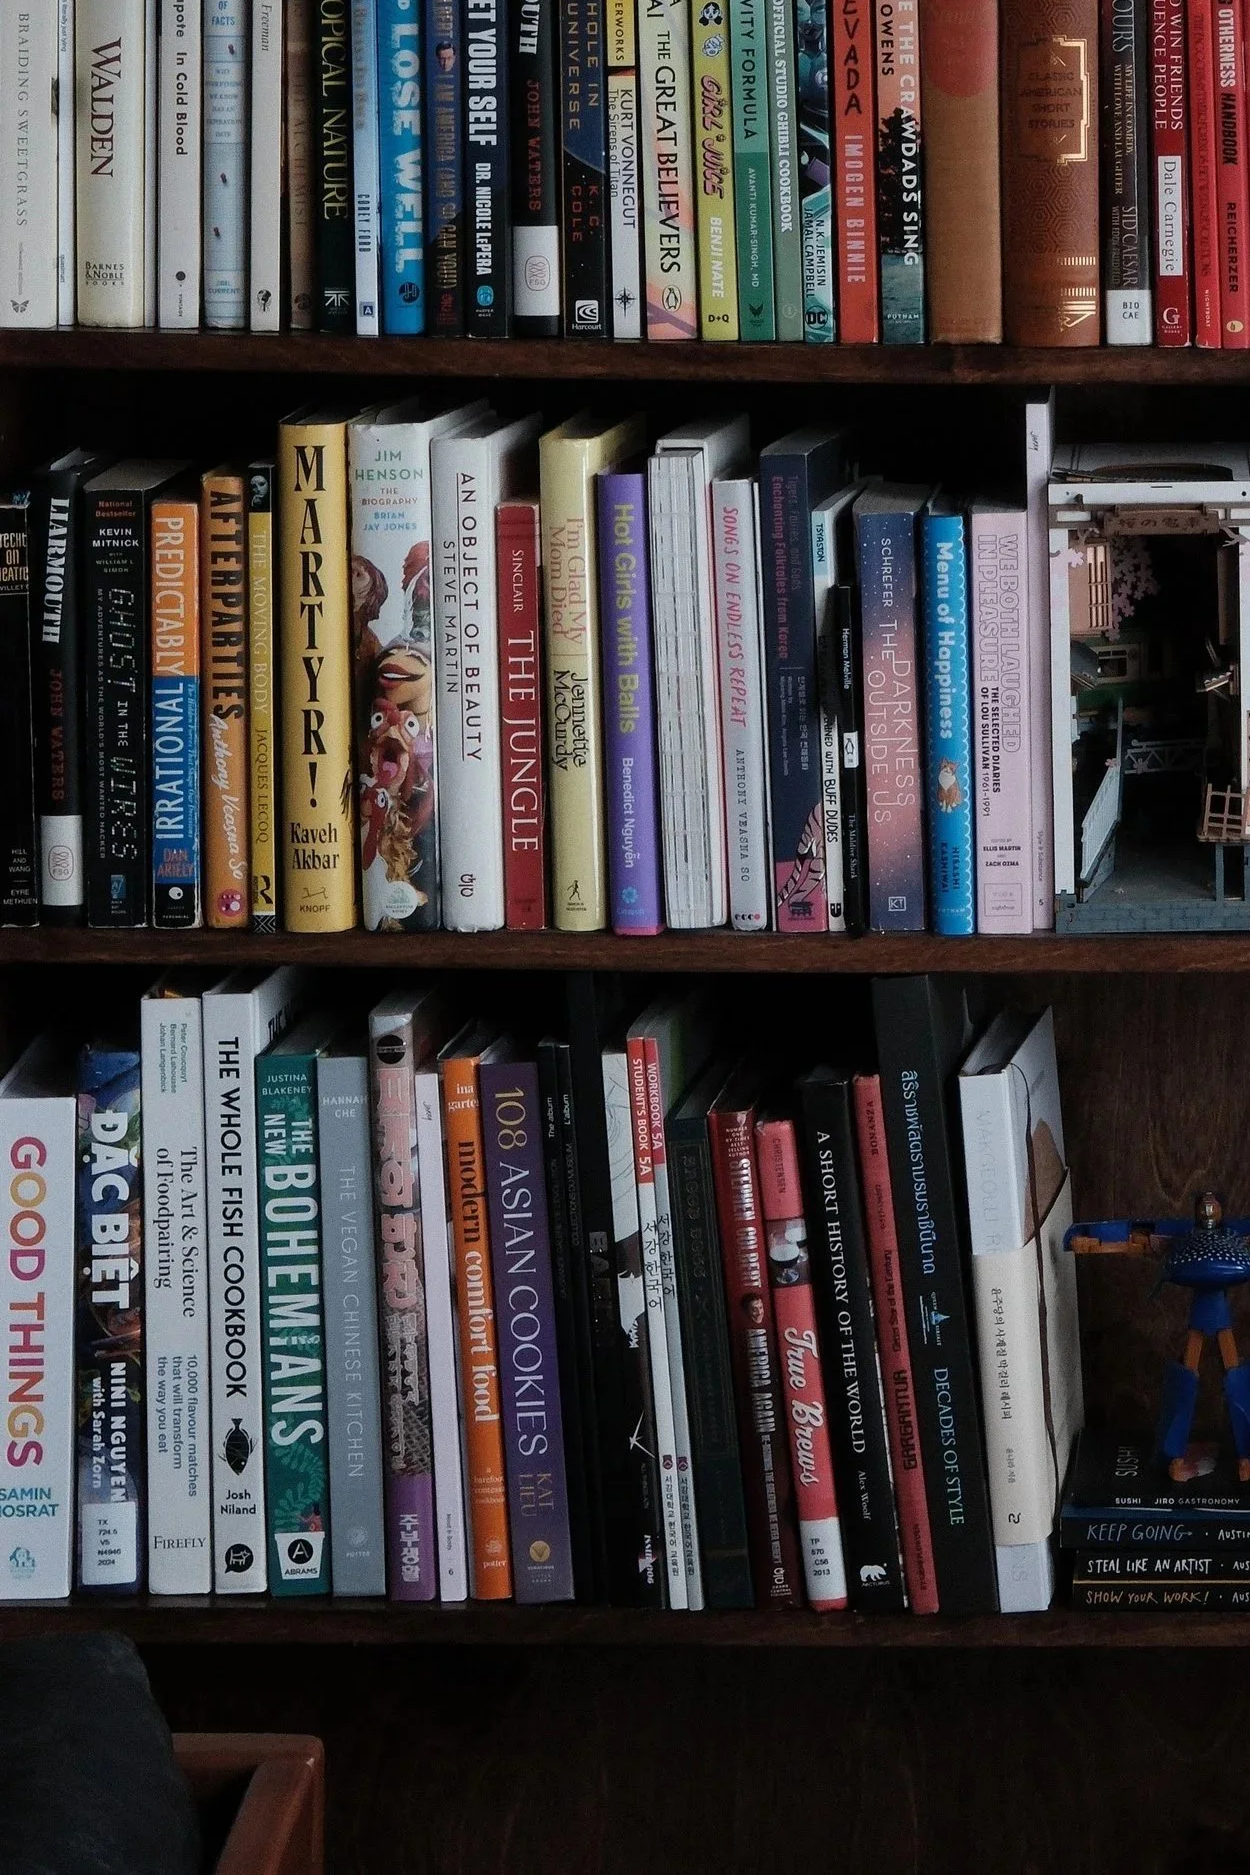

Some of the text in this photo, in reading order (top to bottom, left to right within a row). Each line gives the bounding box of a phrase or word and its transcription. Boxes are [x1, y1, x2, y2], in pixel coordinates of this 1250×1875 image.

[17, 13, 30, 101] BRAIDING
[90, 37, 121, 177] WALDEN
[176, 52, 188, 155] In Cold Blood
[469, 28, 496, 89] YOUR
[17, 110, 29, 226] SWEETGRASS
[323, 109, 348, 220] NATURE
[391, 23, 423, 273] LOSE WELL
[469, 96, 497, 145] SELF
[655, 31, 680, 273] THE GREAT BELIEVERS
[1163, 161, 1178, 271] Dale Carnegie
[1226, 202, 1239, 293] REICHERZER
[41, 497, 68, 644] LIARMOUTH
[92, 539, 139, 548] MITNICK
[97, 529, 132, 537] KEVIN
[880, 538, 892, 607] SCHREFER
[154, 517, 184, 675] PREDICTABLY
[210, 491, 244, 720] AFTERPARTIES
[294, 445, 327, 809] MARTYR!
[462, 473, 482, 761] AN OBJECT OF BEAUTY
[613, 504, 639, 733] Hot Girls with Balls
[935, 542, 957, 739] Menu of Happiness
[155, 683, 184, 840] IRRATIONAL
[551, 670, 571, 771] McCurdy
[571, 672, 588, 768] Jennette
[620, 757, 640, 868] Benedict Nguyễn
[265, 1113, 286, 1155] NEW
[290, 1118, 313, 1155] THE
[636, 1119, 649, 1152] BOOK
[646, 1063, 664, 1149] WORKBOOK 5A
[155, 1148, 177, 1289] of Foodpairing
[180, 1147, 198, 1185] The
[180, 1190, 199, 1220] Art
[218, 1037, 247, 1398] THE WHOLE FISH COOKBOOK
[639, 1157, 652, 1175] 5A
[8, 1136, 46, 1467] GOOD THINGS
[182, 1246, 201, 1317] Science
[458, 1140, 498, 1422] modern comfort food
[494, 1088, 547, 1456] 108 ASIAN COOKIES
[110, 1362, 126, 1502] NINI NGUYEN
[155, 1356, 168, 1453] the way you eat
[173, 1356, 184, 1469] that will transform
[185, 1355, 200, 1496] 10,000 flavour matches
[783, 1328, 825, 1486] True Brews
[932, 1368, 964, 1525] DECADES OF STYLE
[219, 1504, 256, 1515] Niland
[225, 1489, 253, 1501] Josh
[1086, 1591, 1209, 1604] SHOW YOUR WORK!
[1088, 1558, 1212, 1573] STEAL LIKE AN ARTIST
